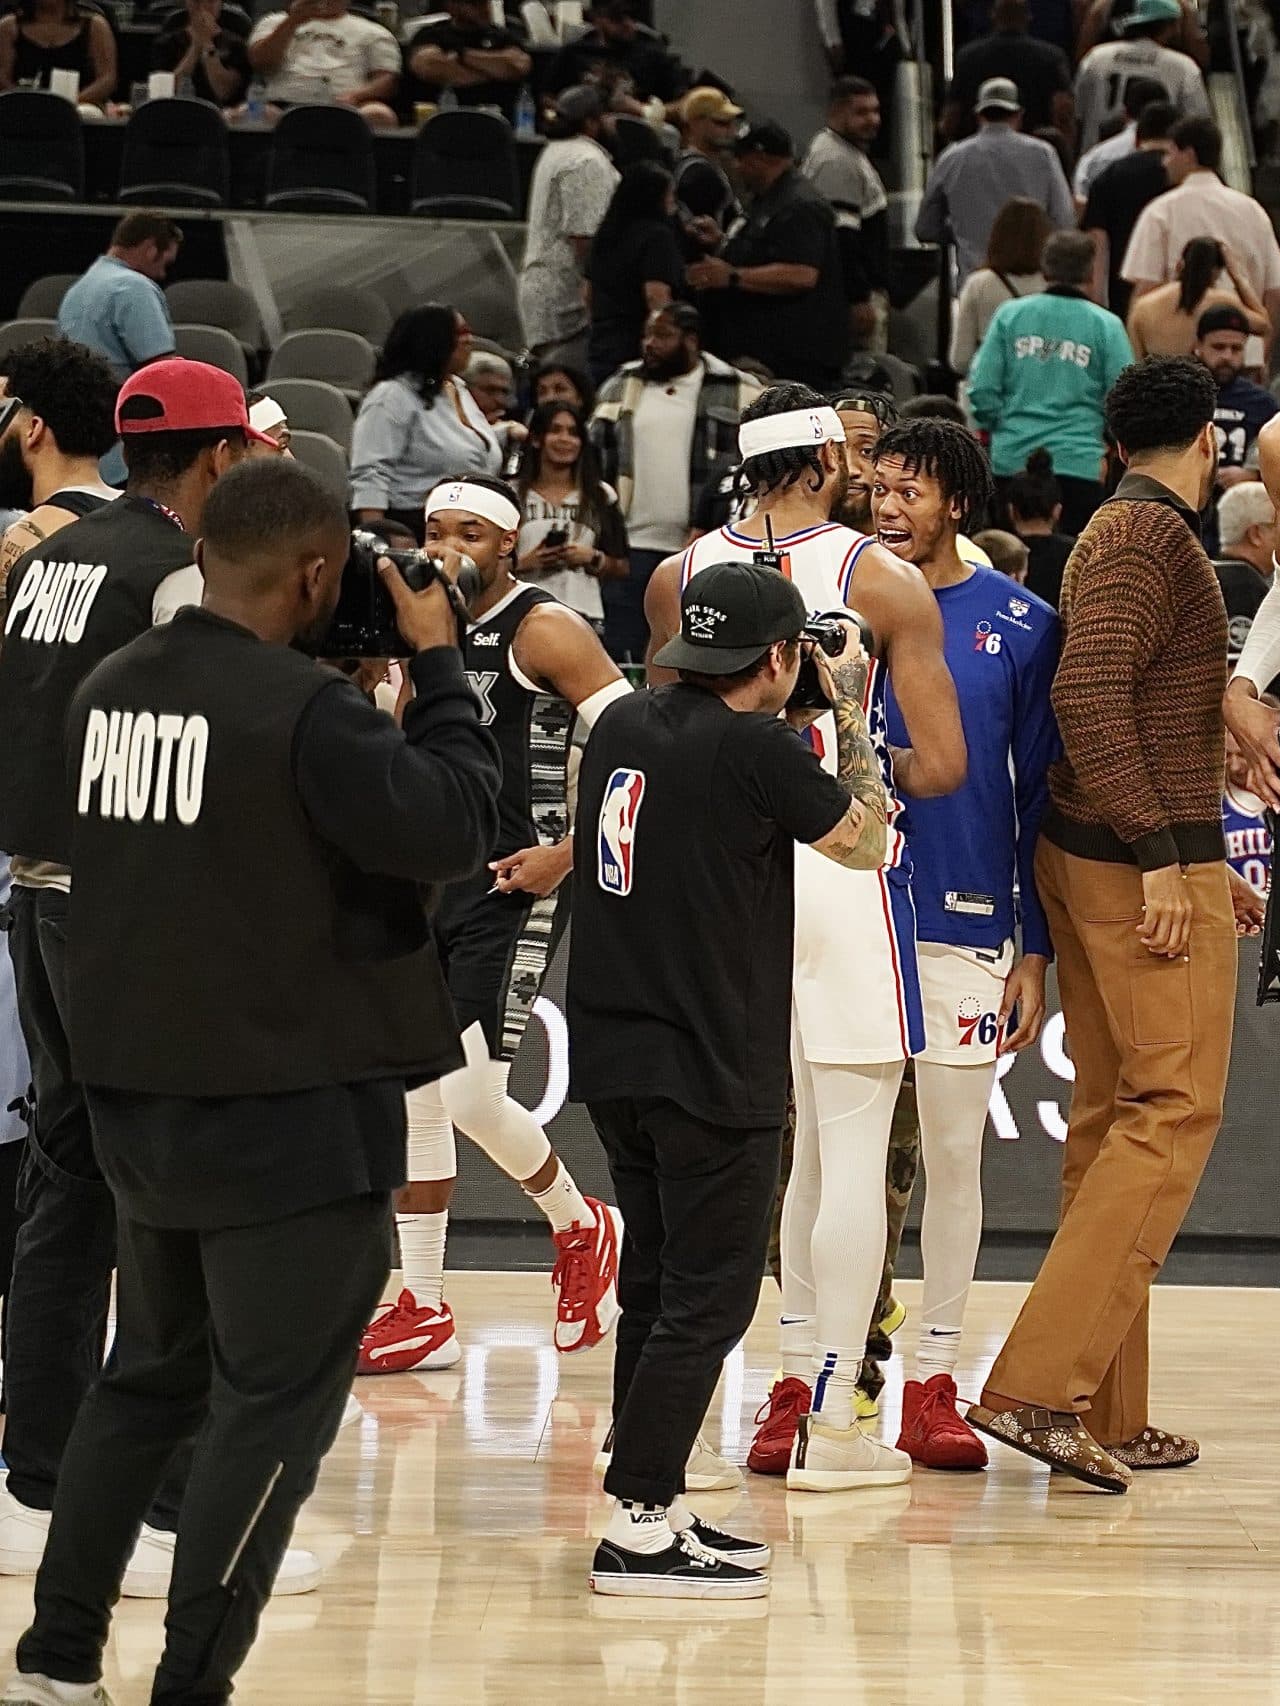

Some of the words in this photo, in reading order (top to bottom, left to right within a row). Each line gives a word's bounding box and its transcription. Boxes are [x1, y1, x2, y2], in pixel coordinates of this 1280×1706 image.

[4, 560, 108, 644] PHOTO
[473, 632, 501, 646] Self.
[974, 632, 1002, 655] 76
[77, 708, 209, 826] PHOTO
[957, 1012, 998, 1046] 76
[630, 1512, 667, 1524] VAN
